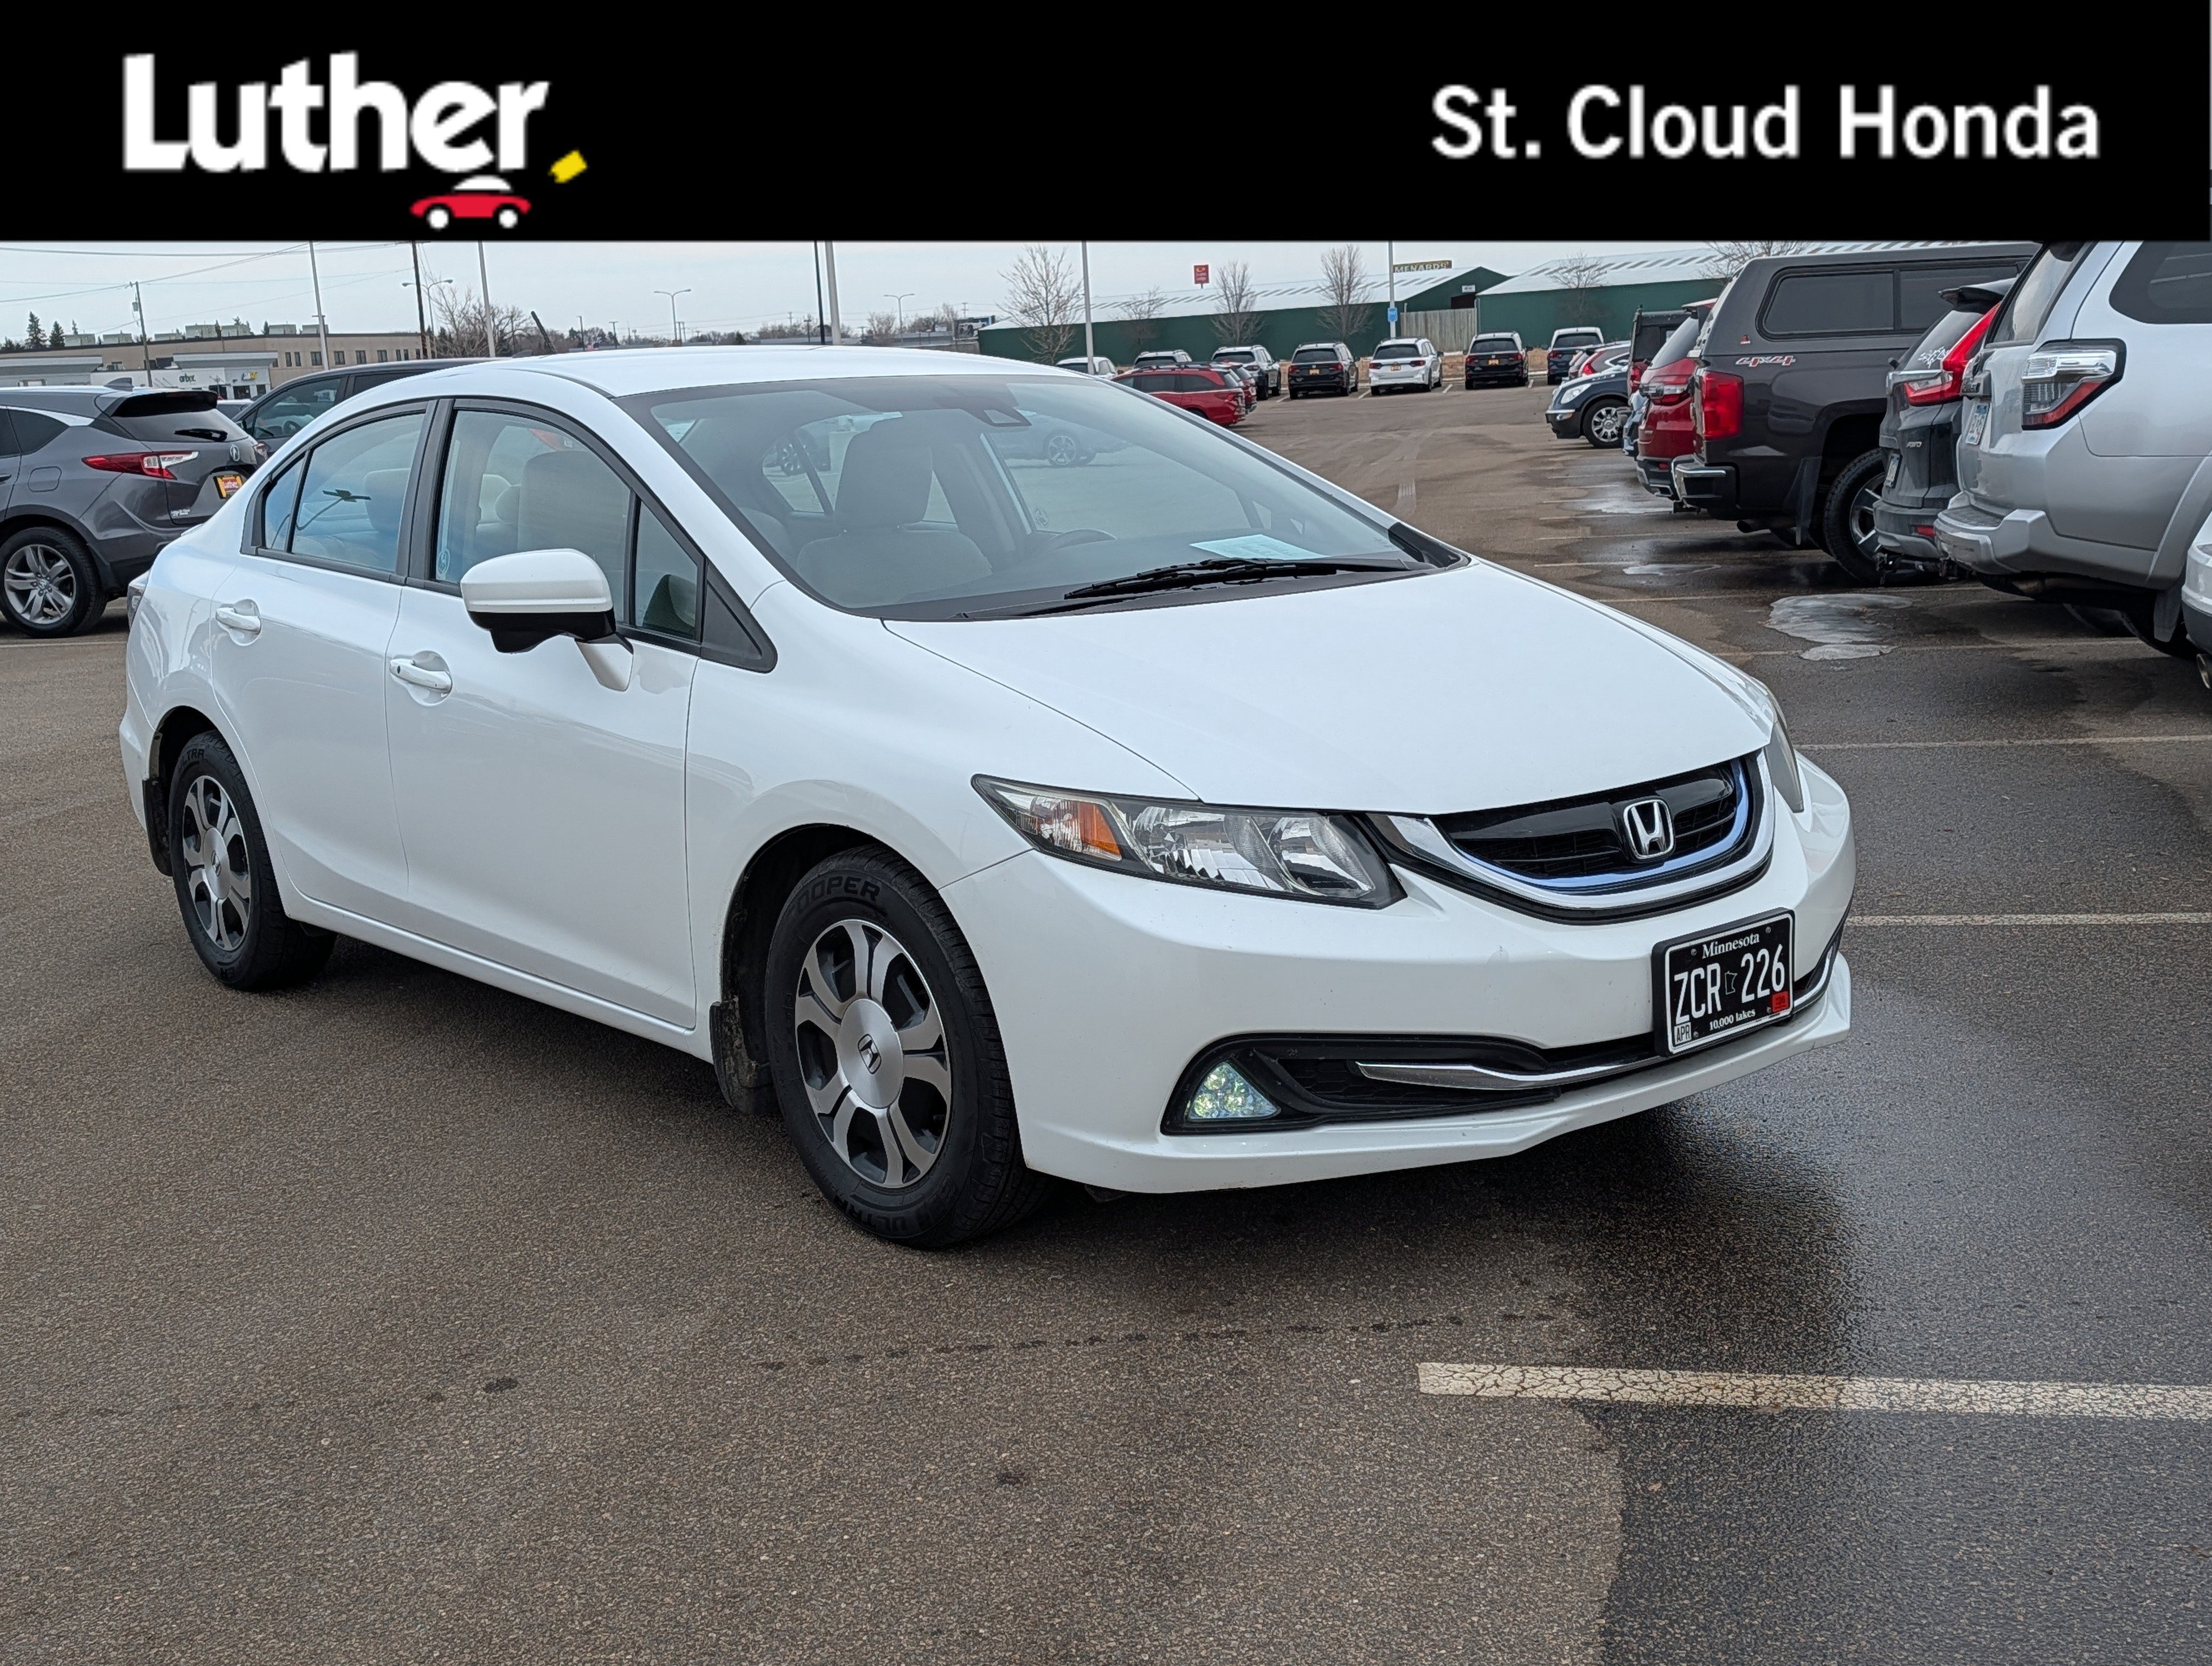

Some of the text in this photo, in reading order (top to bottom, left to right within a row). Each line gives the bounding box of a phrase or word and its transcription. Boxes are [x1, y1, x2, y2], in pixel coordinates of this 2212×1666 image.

[1701, 933, 1760, 959] Minnesota
[1674, 944, 1785, 1025] ZCR 226
[1709, 1008, 1756, 1031] 10,000 lakes
[1676, 1025, 1691, 1043] APR
